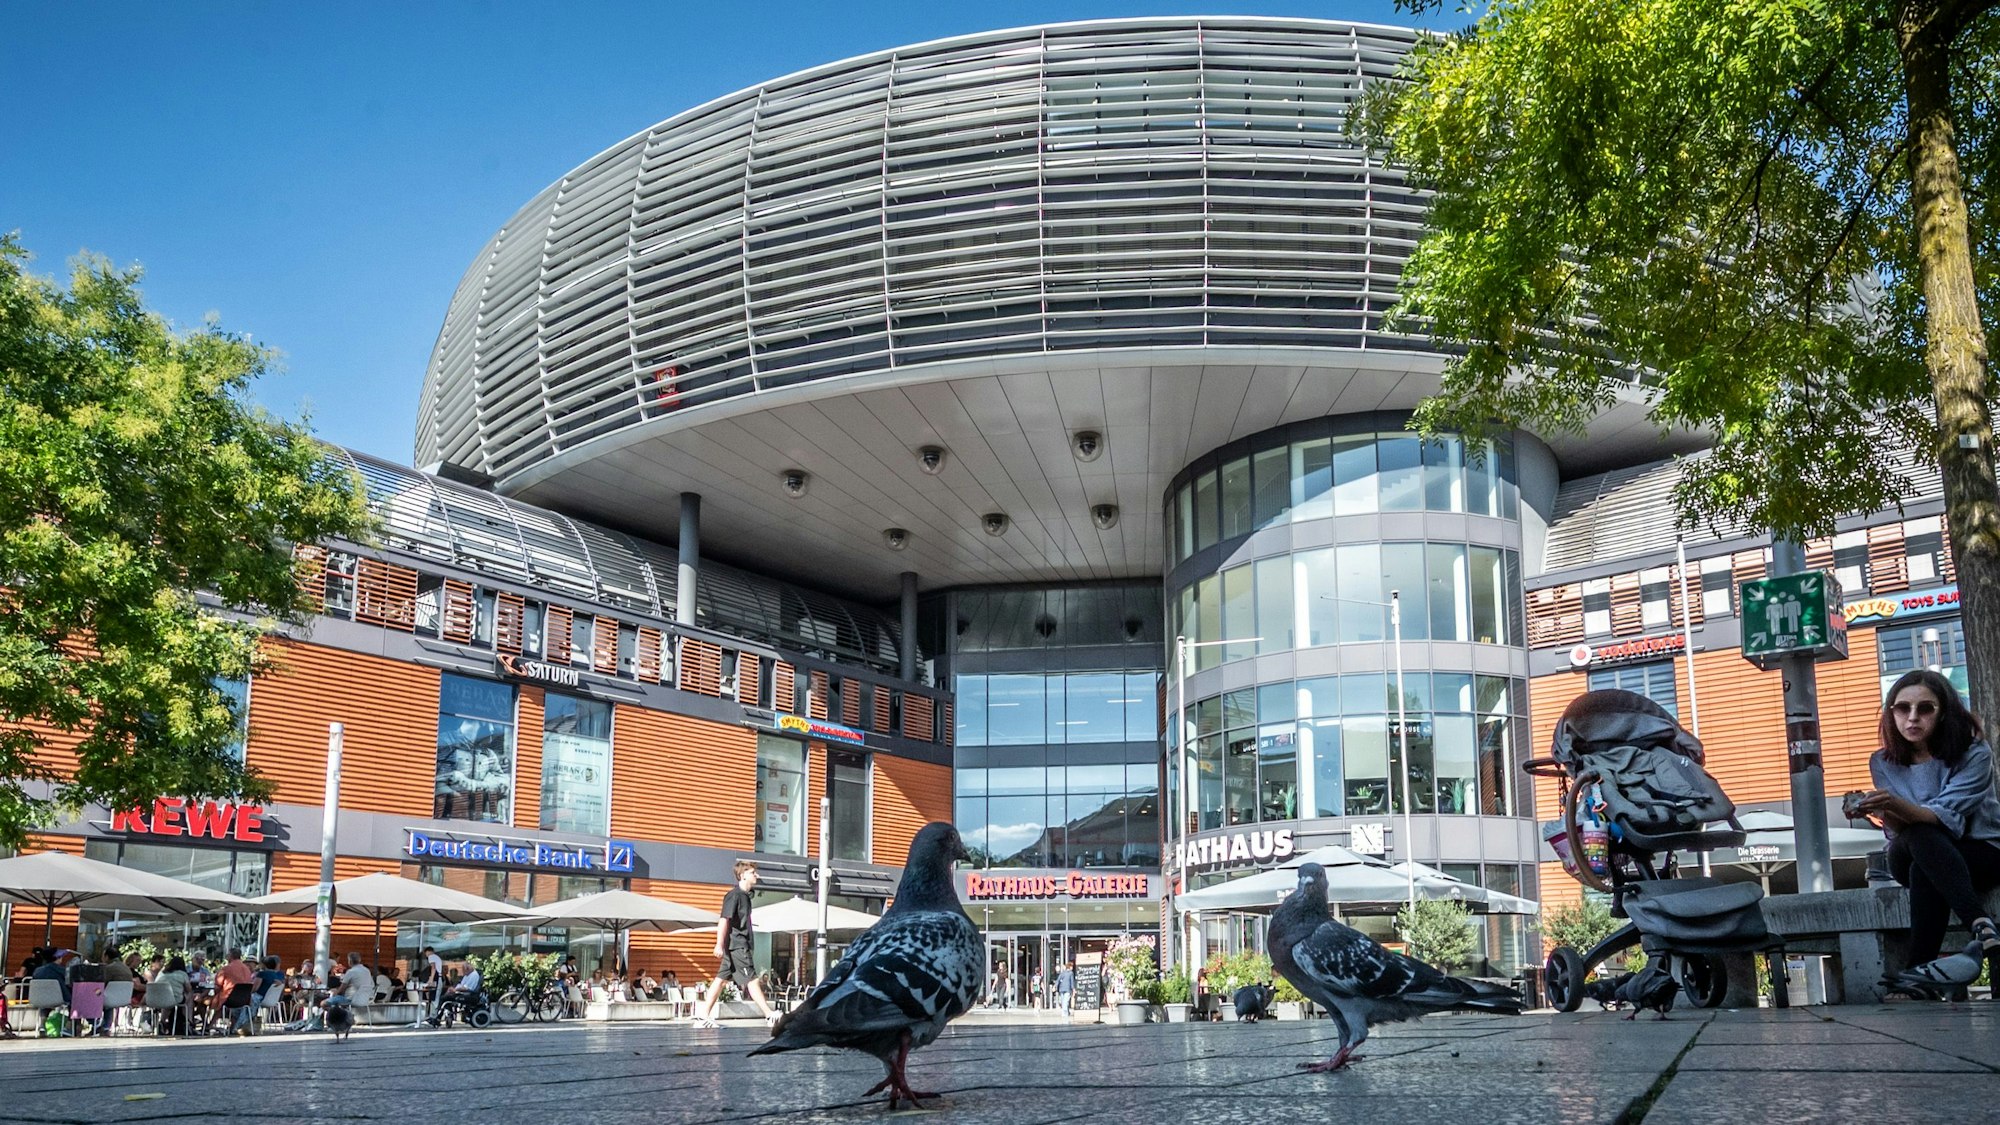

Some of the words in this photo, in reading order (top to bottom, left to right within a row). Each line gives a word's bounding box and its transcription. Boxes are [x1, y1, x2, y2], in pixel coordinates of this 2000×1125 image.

[1843, 601, 1896, 617] MYTHS
[1902, 595, 1935, 611] TOYS
[1597, 634, 1686, 658] vodafone
[526, 660, 579, 687] SATURN
[780, 716, 810, 732] SMYTHS
[110, 797, 264, 843] REWE
[410, 832, 530, 864] Deutsche
[534, 841, 593, 869] Bank
[1737, 846, 1749, 857] Die
[1750, 846, 1780, 855] Brasserie
